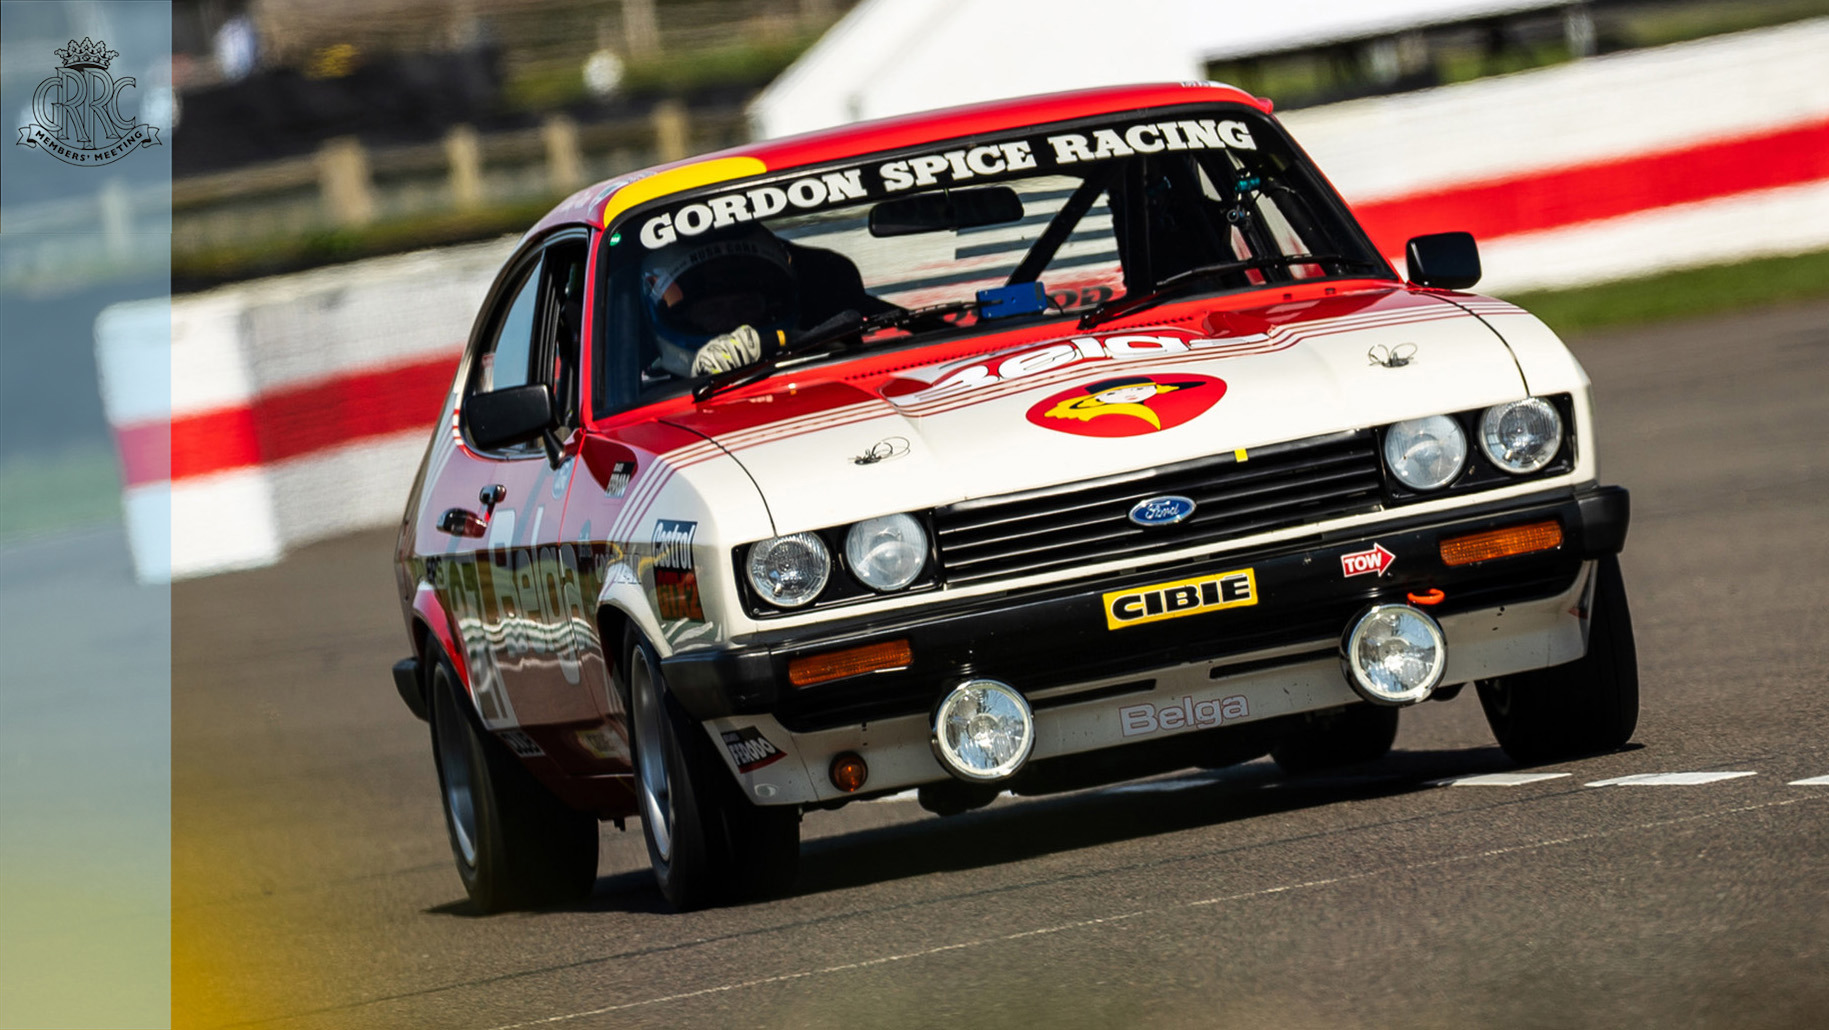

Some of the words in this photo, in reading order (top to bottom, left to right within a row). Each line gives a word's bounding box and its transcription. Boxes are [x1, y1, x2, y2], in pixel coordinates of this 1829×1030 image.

[640, 169, 867, 249] GORDON
[880, 141, 1037, 192] SPICE
[1047, 119, 1257, 165] RACING
[1144, 500, 1180, 520] Ford
[653, 522, 697, 571] Castrol
[1345, 552, 1382, 573] TOW
[1119, 694, 1250, 737] Belga
